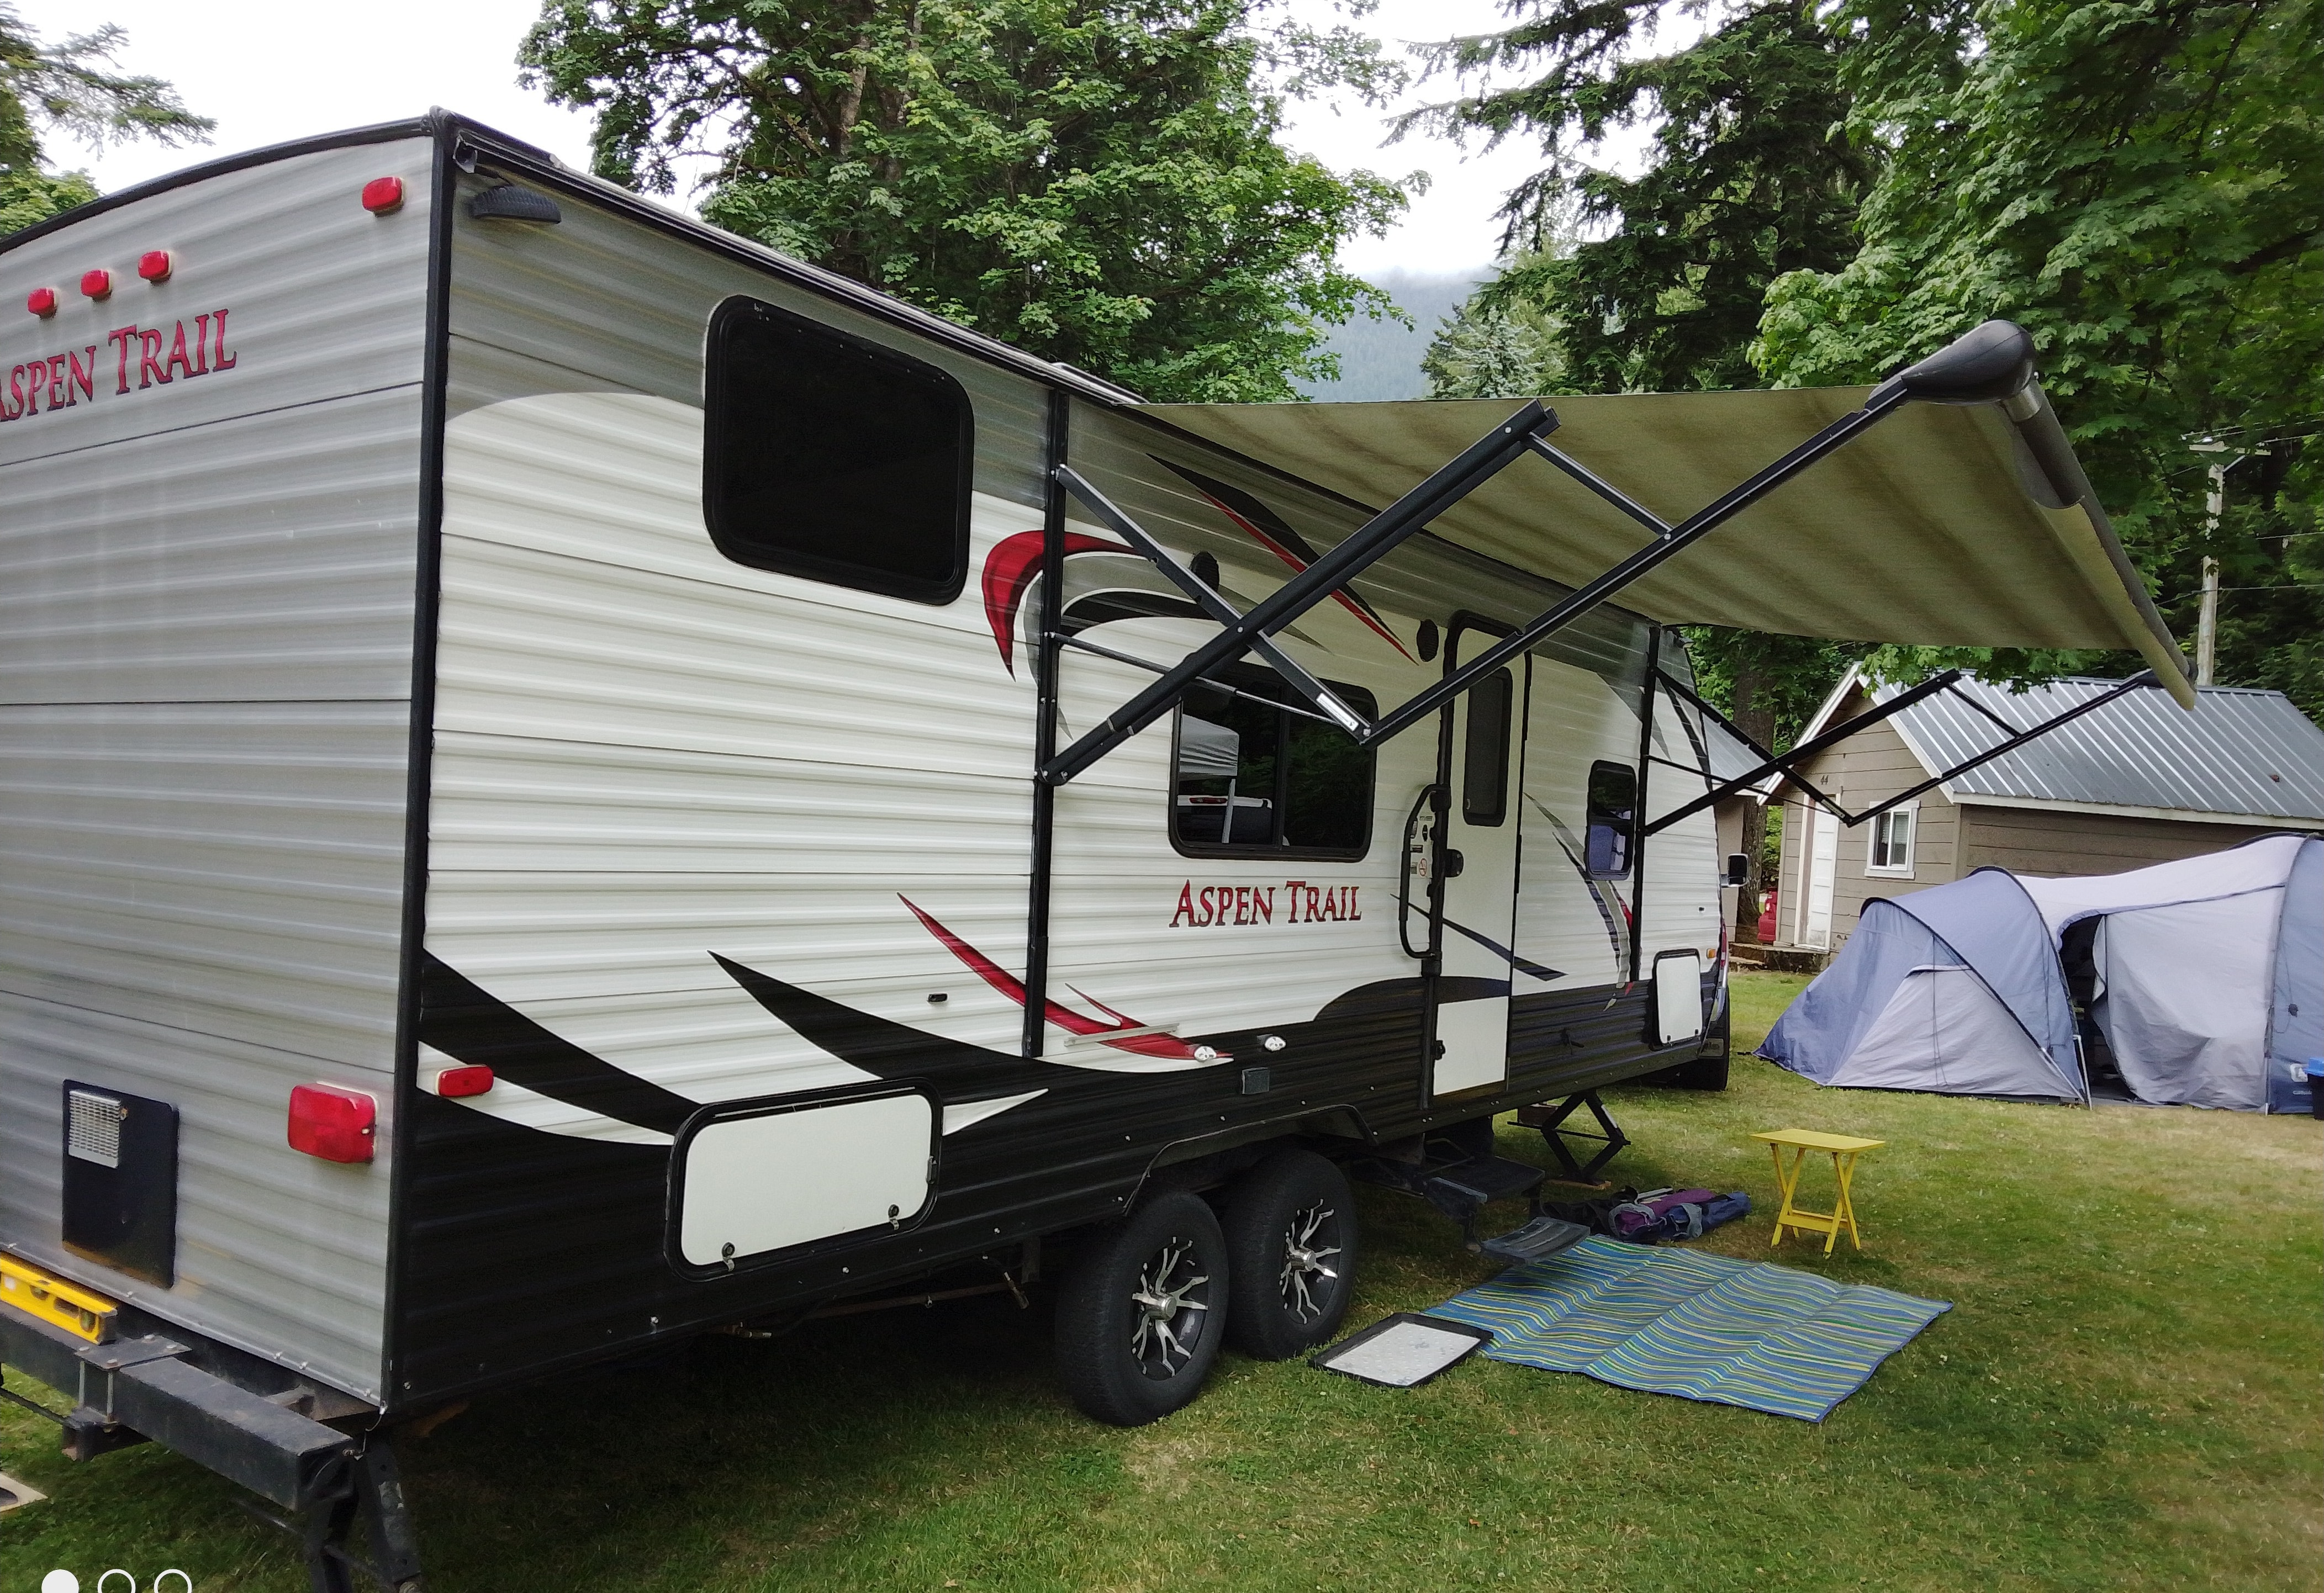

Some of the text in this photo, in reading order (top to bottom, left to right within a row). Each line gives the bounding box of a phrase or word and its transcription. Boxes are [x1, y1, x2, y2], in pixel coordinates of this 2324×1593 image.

[108, 309, 237, 395] TRAIL
[1820, 775, 1829, 785] 44
[1169, 879, 1362, 928] ASPEN TRAIL
